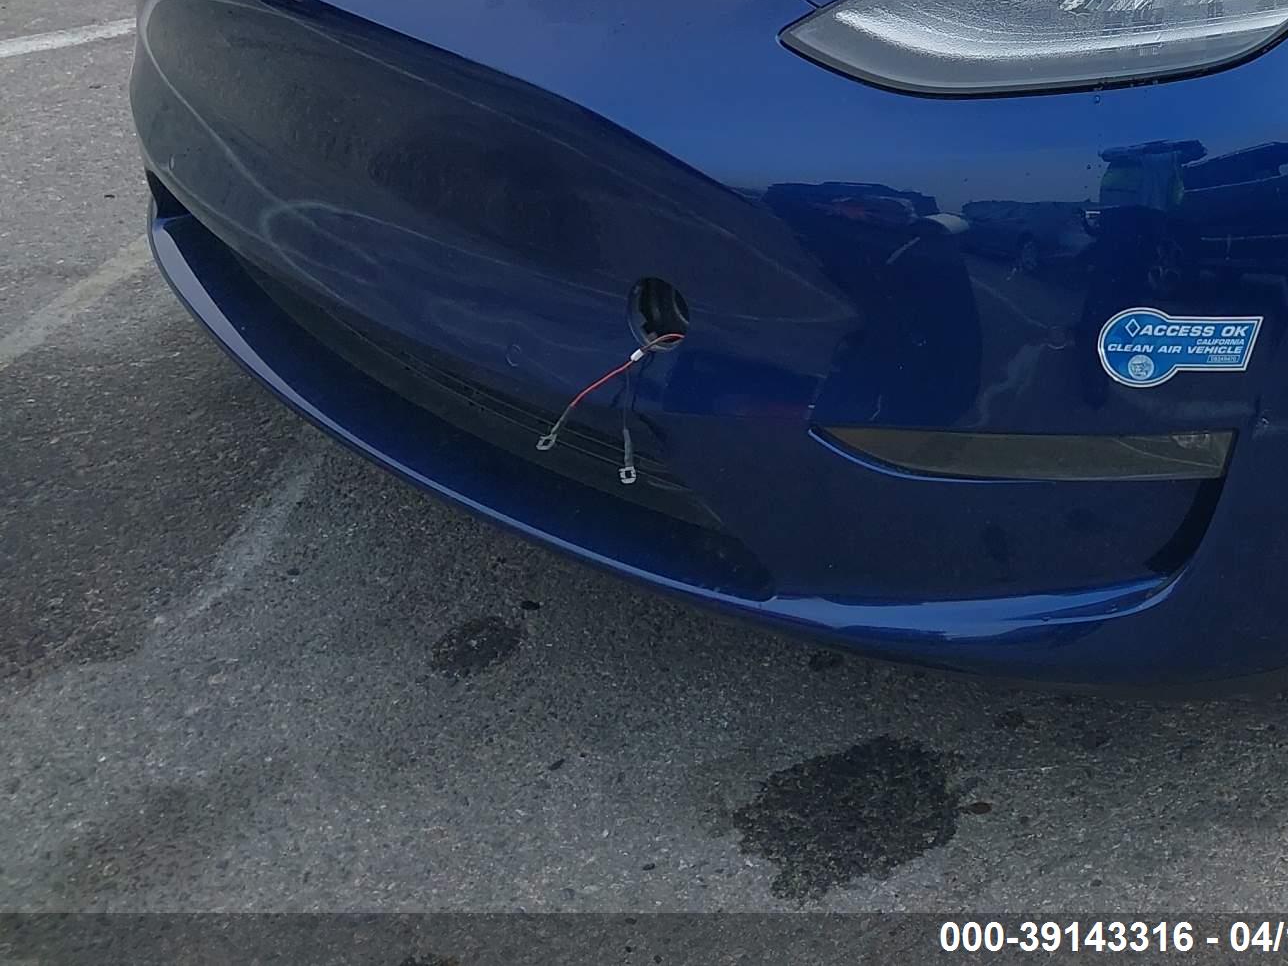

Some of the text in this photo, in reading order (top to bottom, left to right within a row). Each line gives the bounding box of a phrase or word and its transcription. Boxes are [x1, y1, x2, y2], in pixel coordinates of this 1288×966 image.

[1139, 325, 1249, 337] ACCESS OK
[1196, 338, 1244, 346] CALIFORNIA
[1107, 344, 1243, 354] CLEAN AIR VEHICLE
